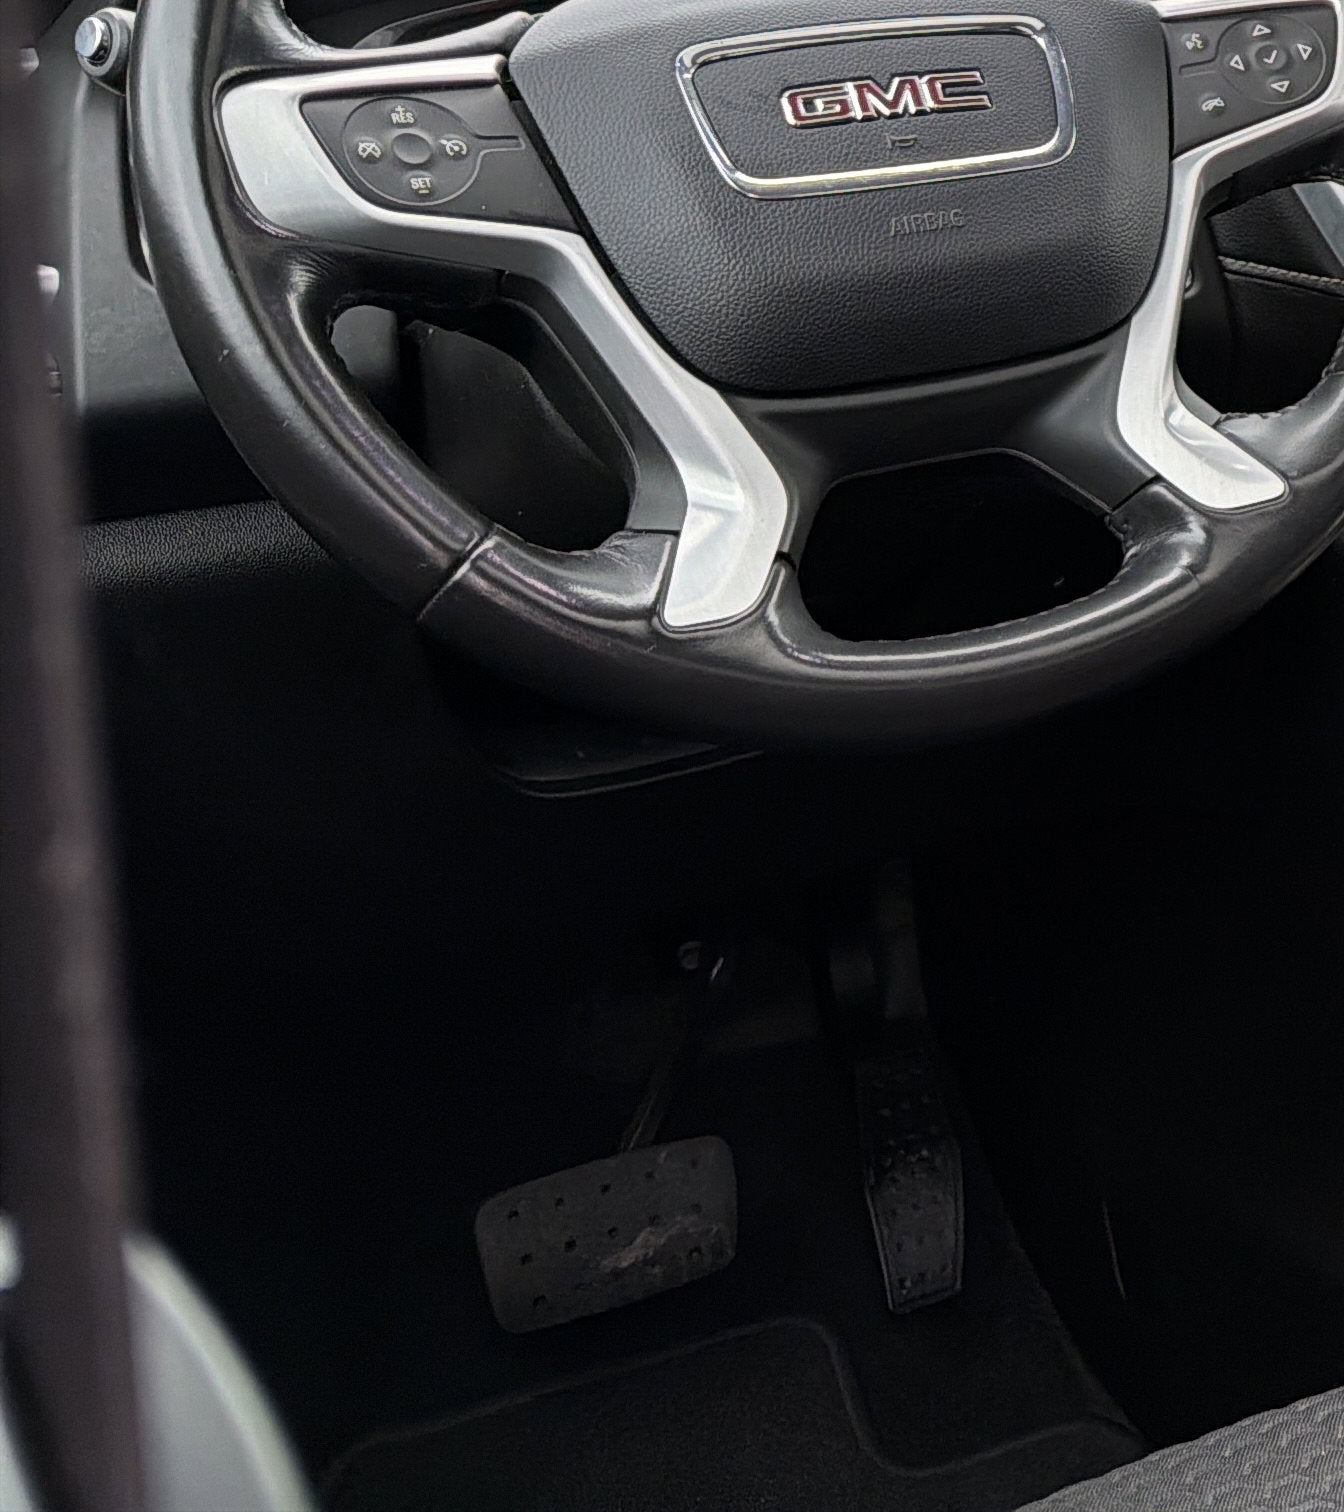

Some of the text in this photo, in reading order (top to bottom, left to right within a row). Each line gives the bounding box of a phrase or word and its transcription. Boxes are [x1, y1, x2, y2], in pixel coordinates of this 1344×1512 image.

[781, 68, 993, 129] GMC
[391, 112, 415, 124] RES
[410, 177, 432, 189] SET
[889, 208, 966, 237] AIRBAG
